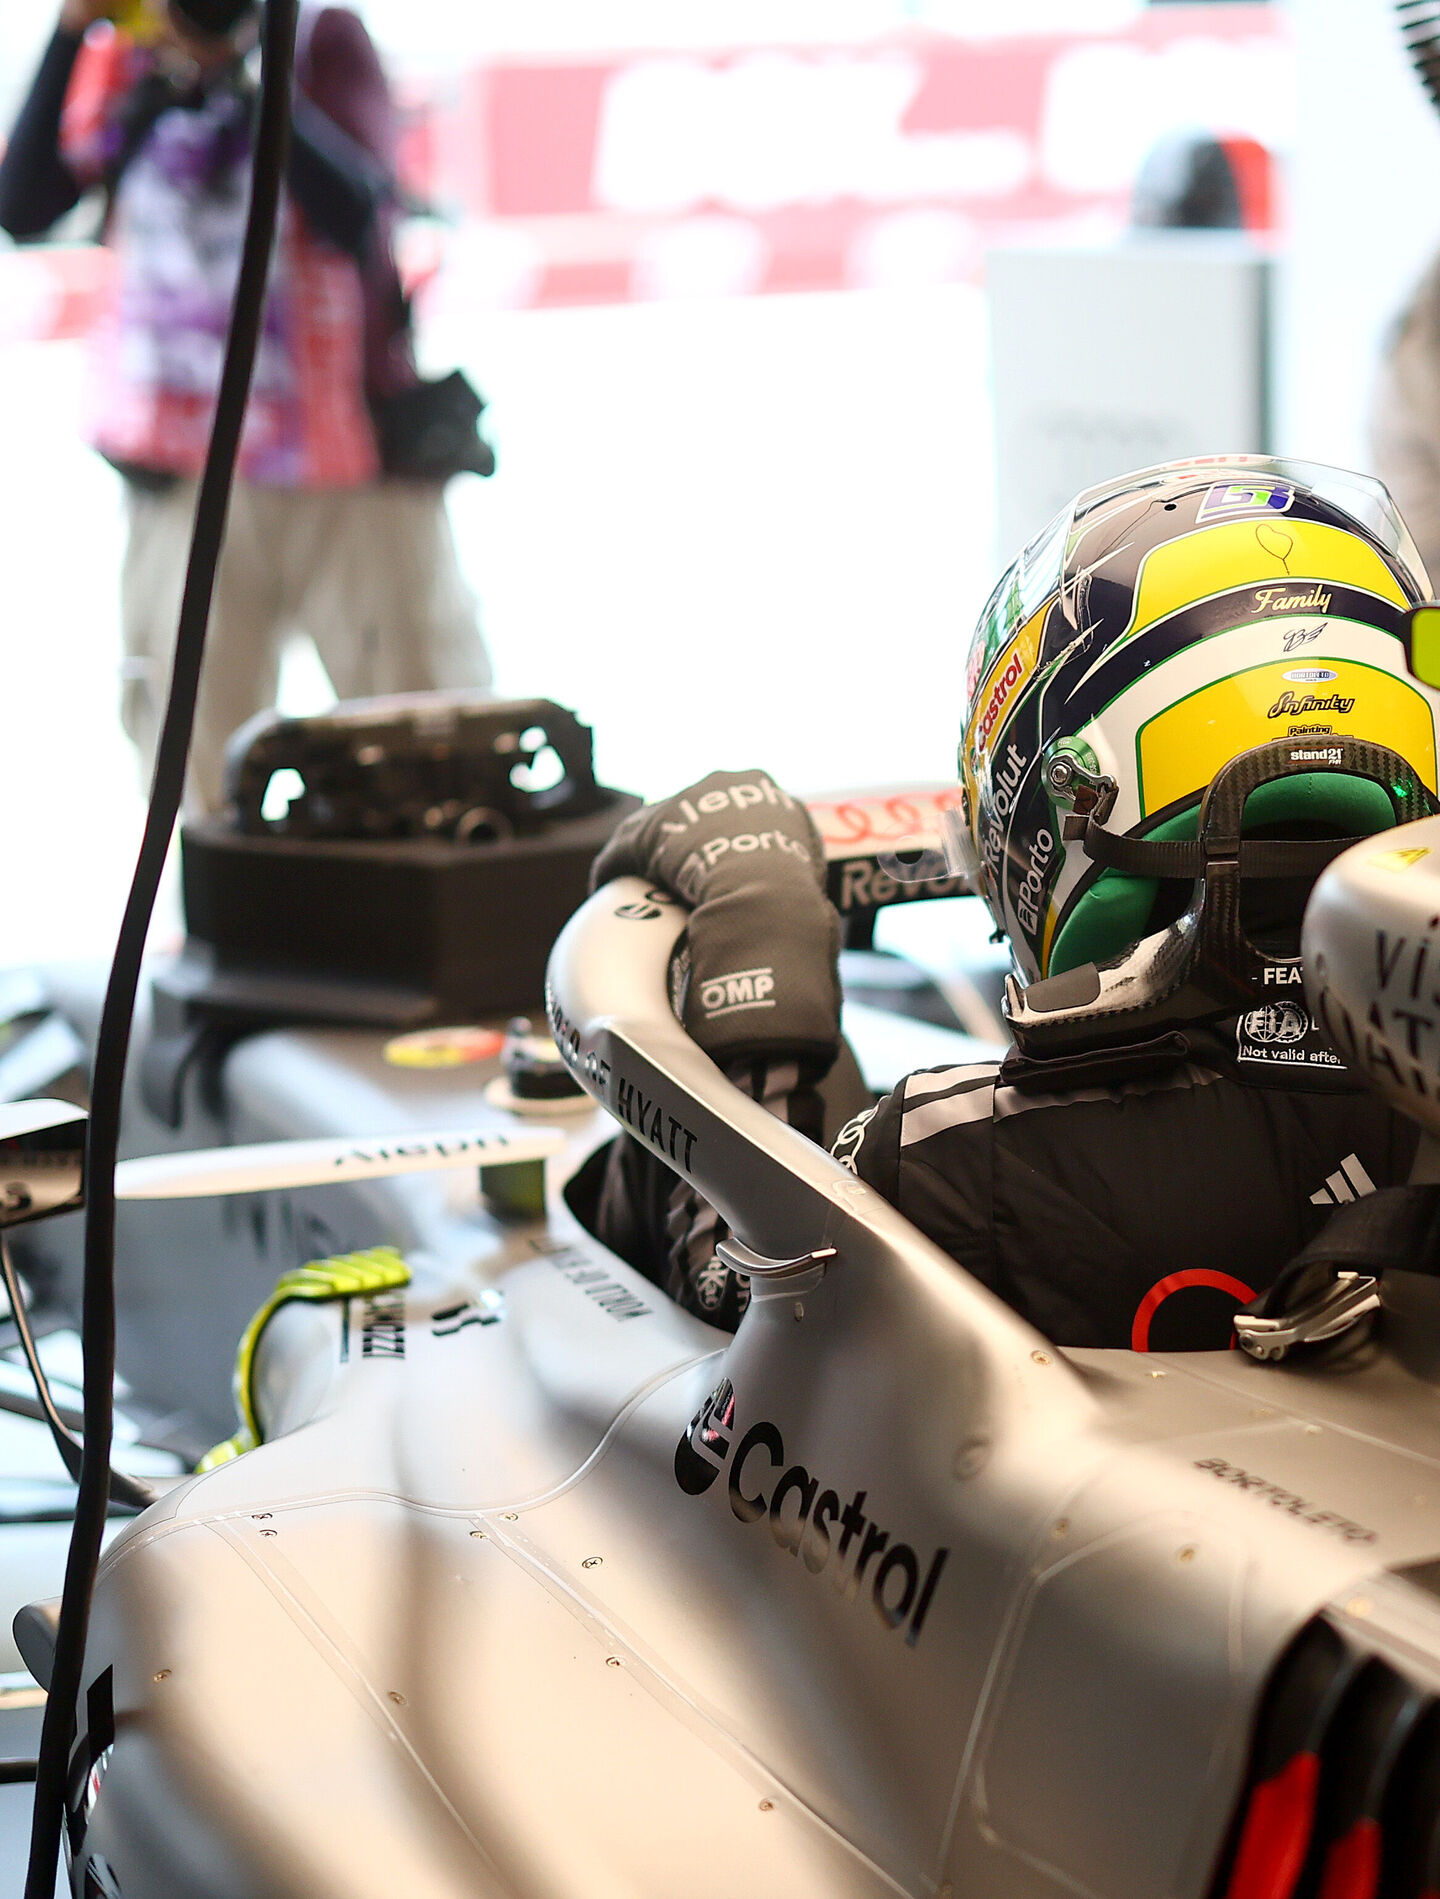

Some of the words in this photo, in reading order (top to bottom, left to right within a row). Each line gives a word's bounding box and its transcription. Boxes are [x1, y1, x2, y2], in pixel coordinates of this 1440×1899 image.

[1251, 584, 1332, 614] Family
[1289, 726, 1331, 735] Painting
[1290, 748, 1342, 761] stand21
[984, 742, 1028, 875] Revolut
[1020, 828, 1054, 910] Porto
[1263, 966, 1303, 985] FEA
[702, 975, 775, 1010] OMP
[1242, 1046, 1268, 1058] Not
[1271, 1048, 1305, 1061] valid
[1310, 1050, 1341, 1064] afte
[618, 1077, 698, 1174] HYATT
[728, 1421, 949, 1647] Castrol
